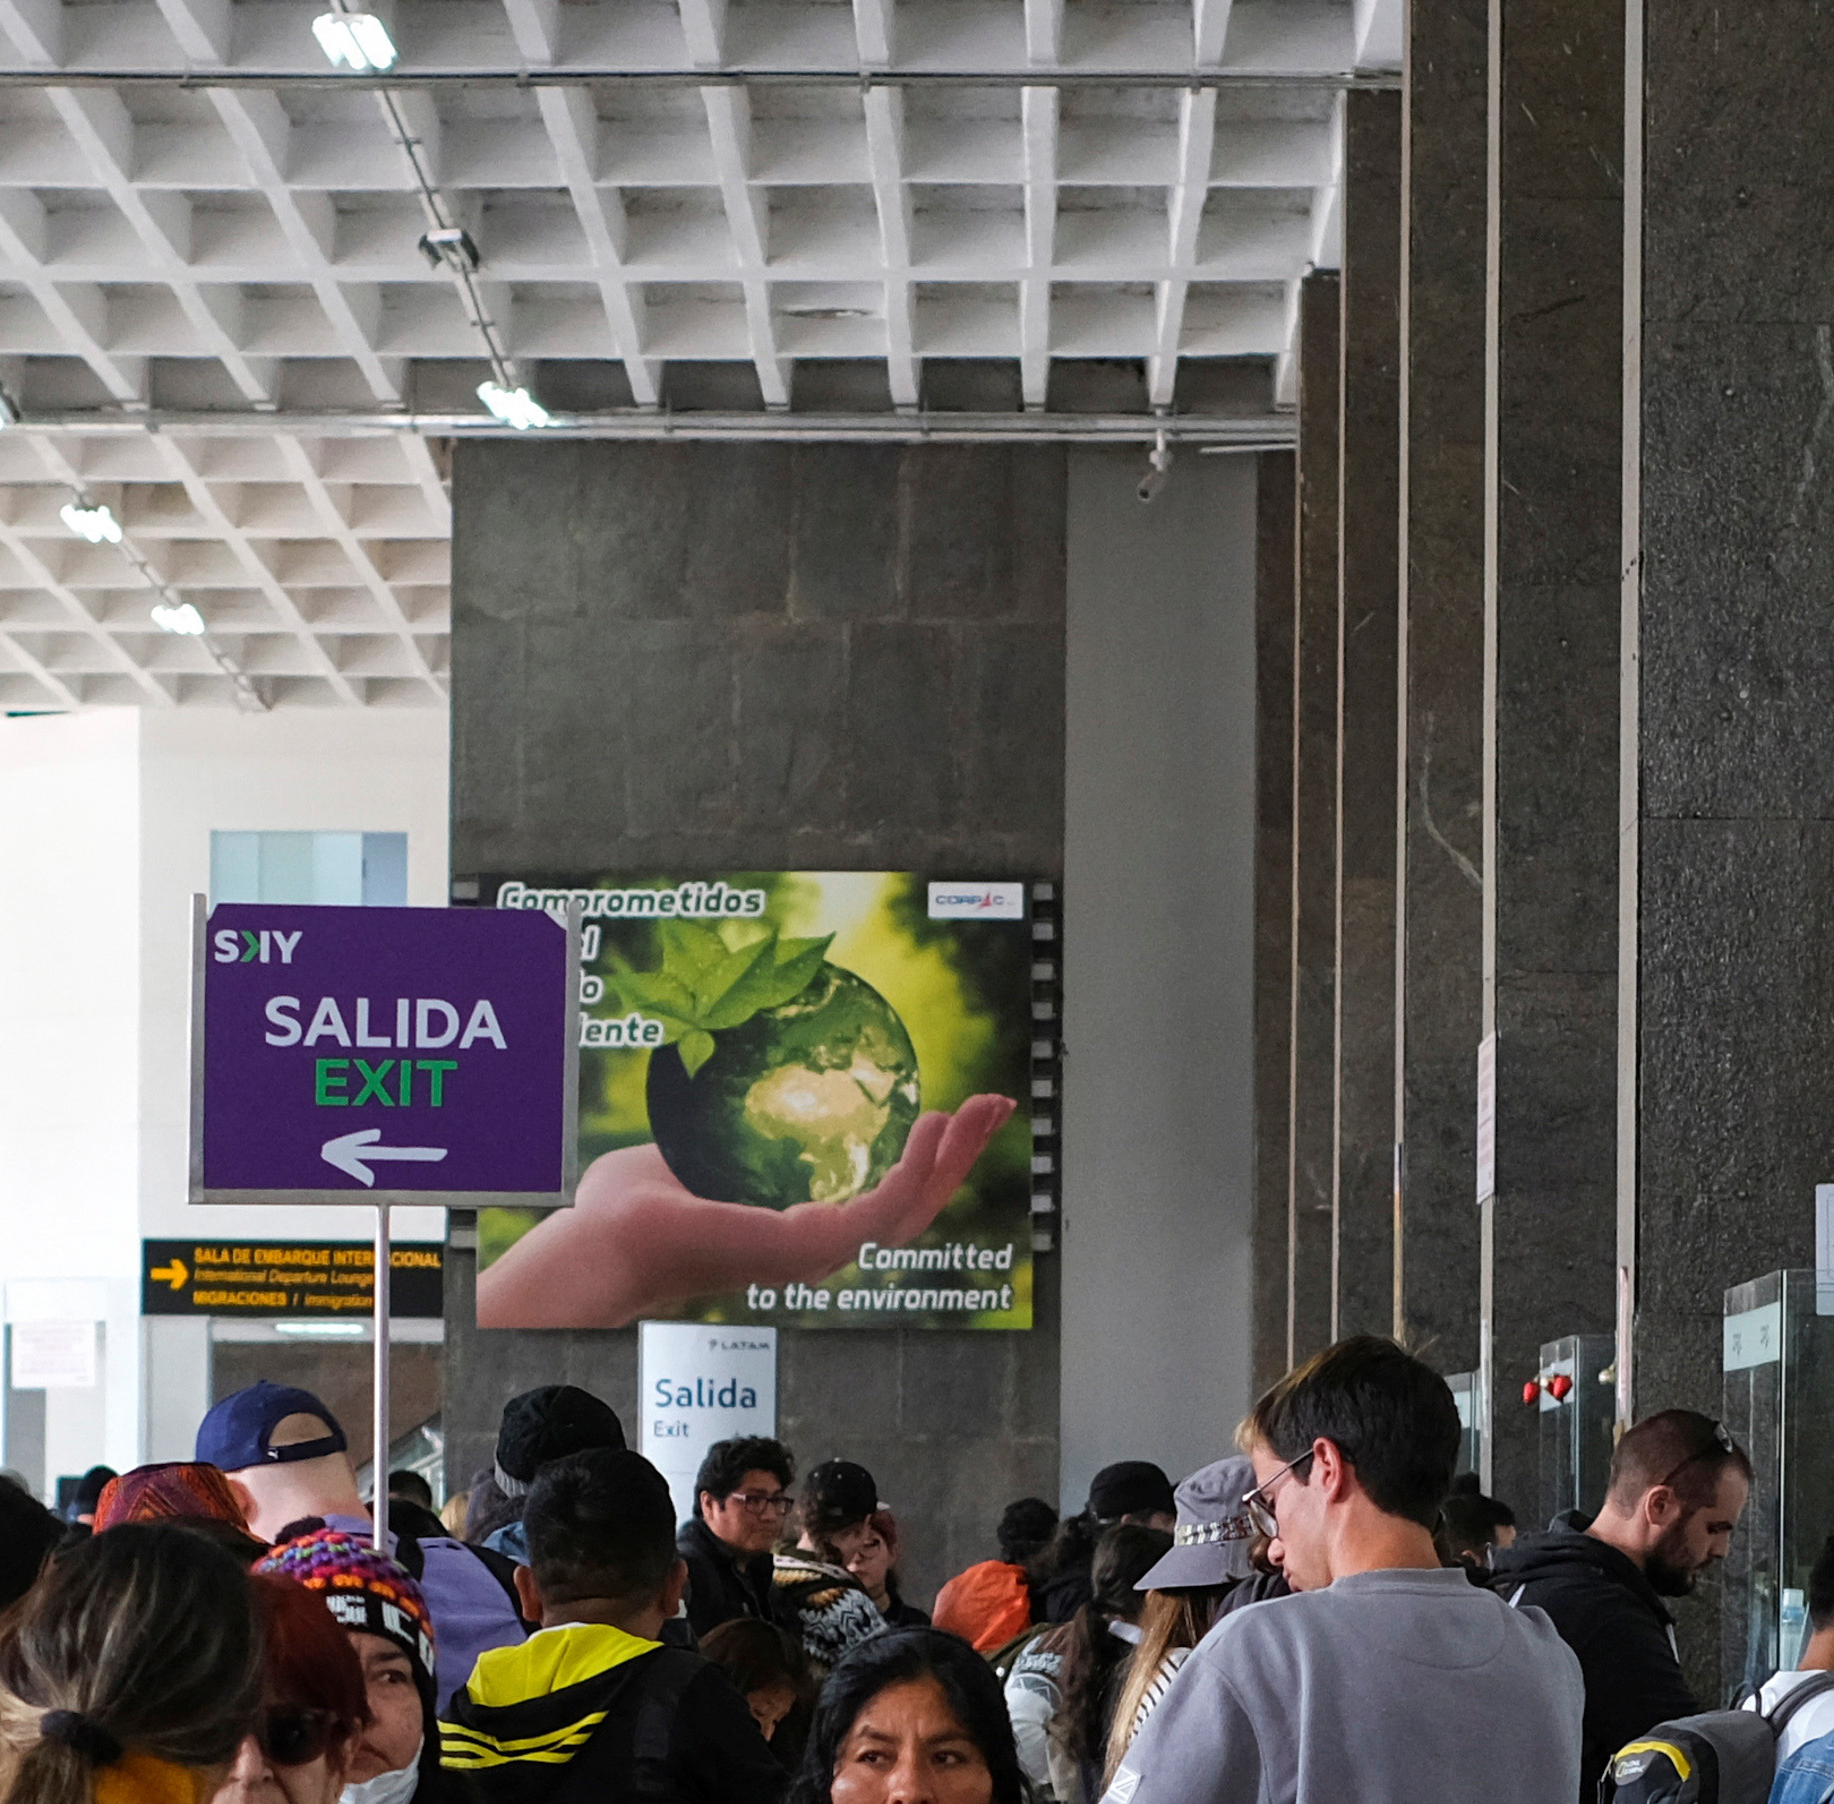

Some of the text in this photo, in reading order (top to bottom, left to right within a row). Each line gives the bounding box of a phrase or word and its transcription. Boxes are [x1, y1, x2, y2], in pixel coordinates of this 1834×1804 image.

[265, 996, 507, 1049] SALIDA
[316, 1059, 458, 1106] EXIT
[195, 1247, 230, 1263] SALA
[233, 1248, 251, 1263] DE
[254, 1249, 330, 1265] EMBARQUE
[858, 1242, 1013, 1269] Committed
[746, 1281, 1012, 1310] to the environment
[655, 1376, 757, 1409] Salida
[654, 1420, 689, 1437] Exit
